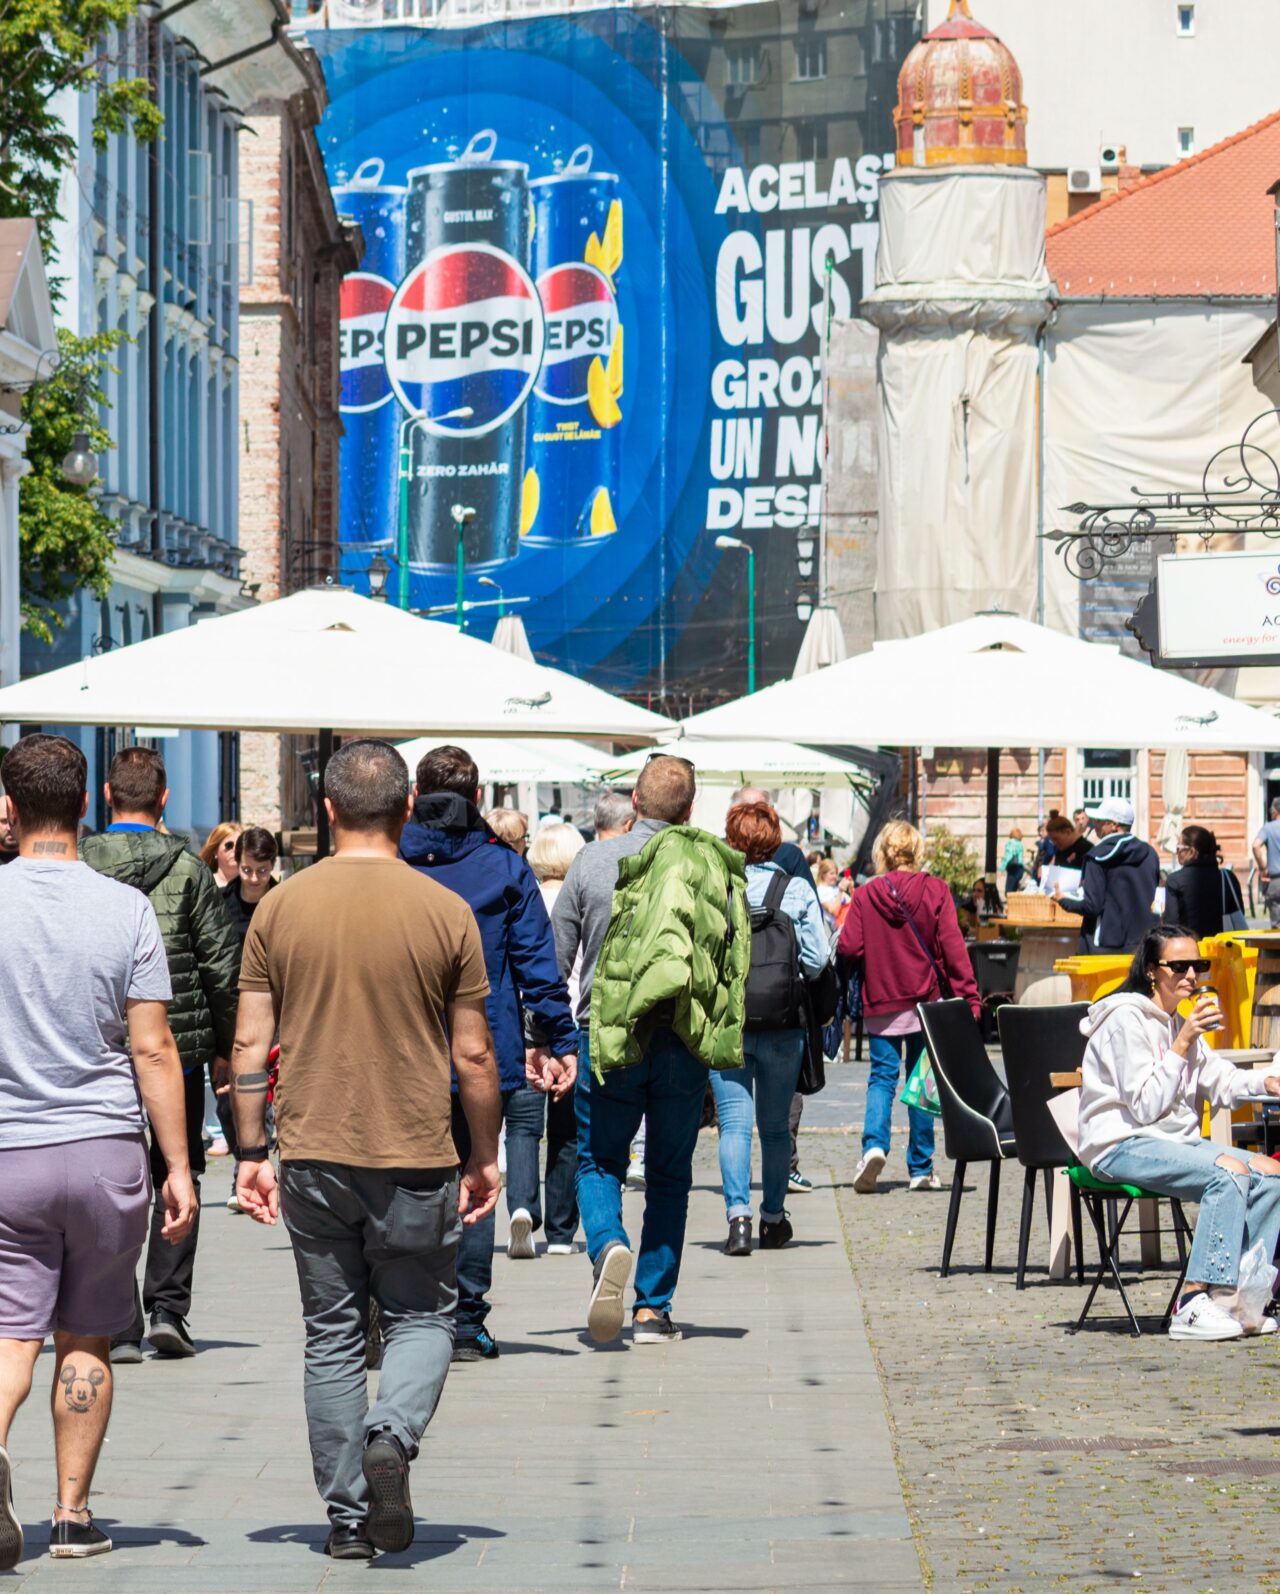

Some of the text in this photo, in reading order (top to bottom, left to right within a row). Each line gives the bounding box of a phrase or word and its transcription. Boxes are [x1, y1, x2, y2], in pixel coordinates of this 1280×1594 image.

[397, 319, 533, 360] PEPSI
[710, 414, 824, 480] UN N
[416, 465, 456, 477] ZERO
